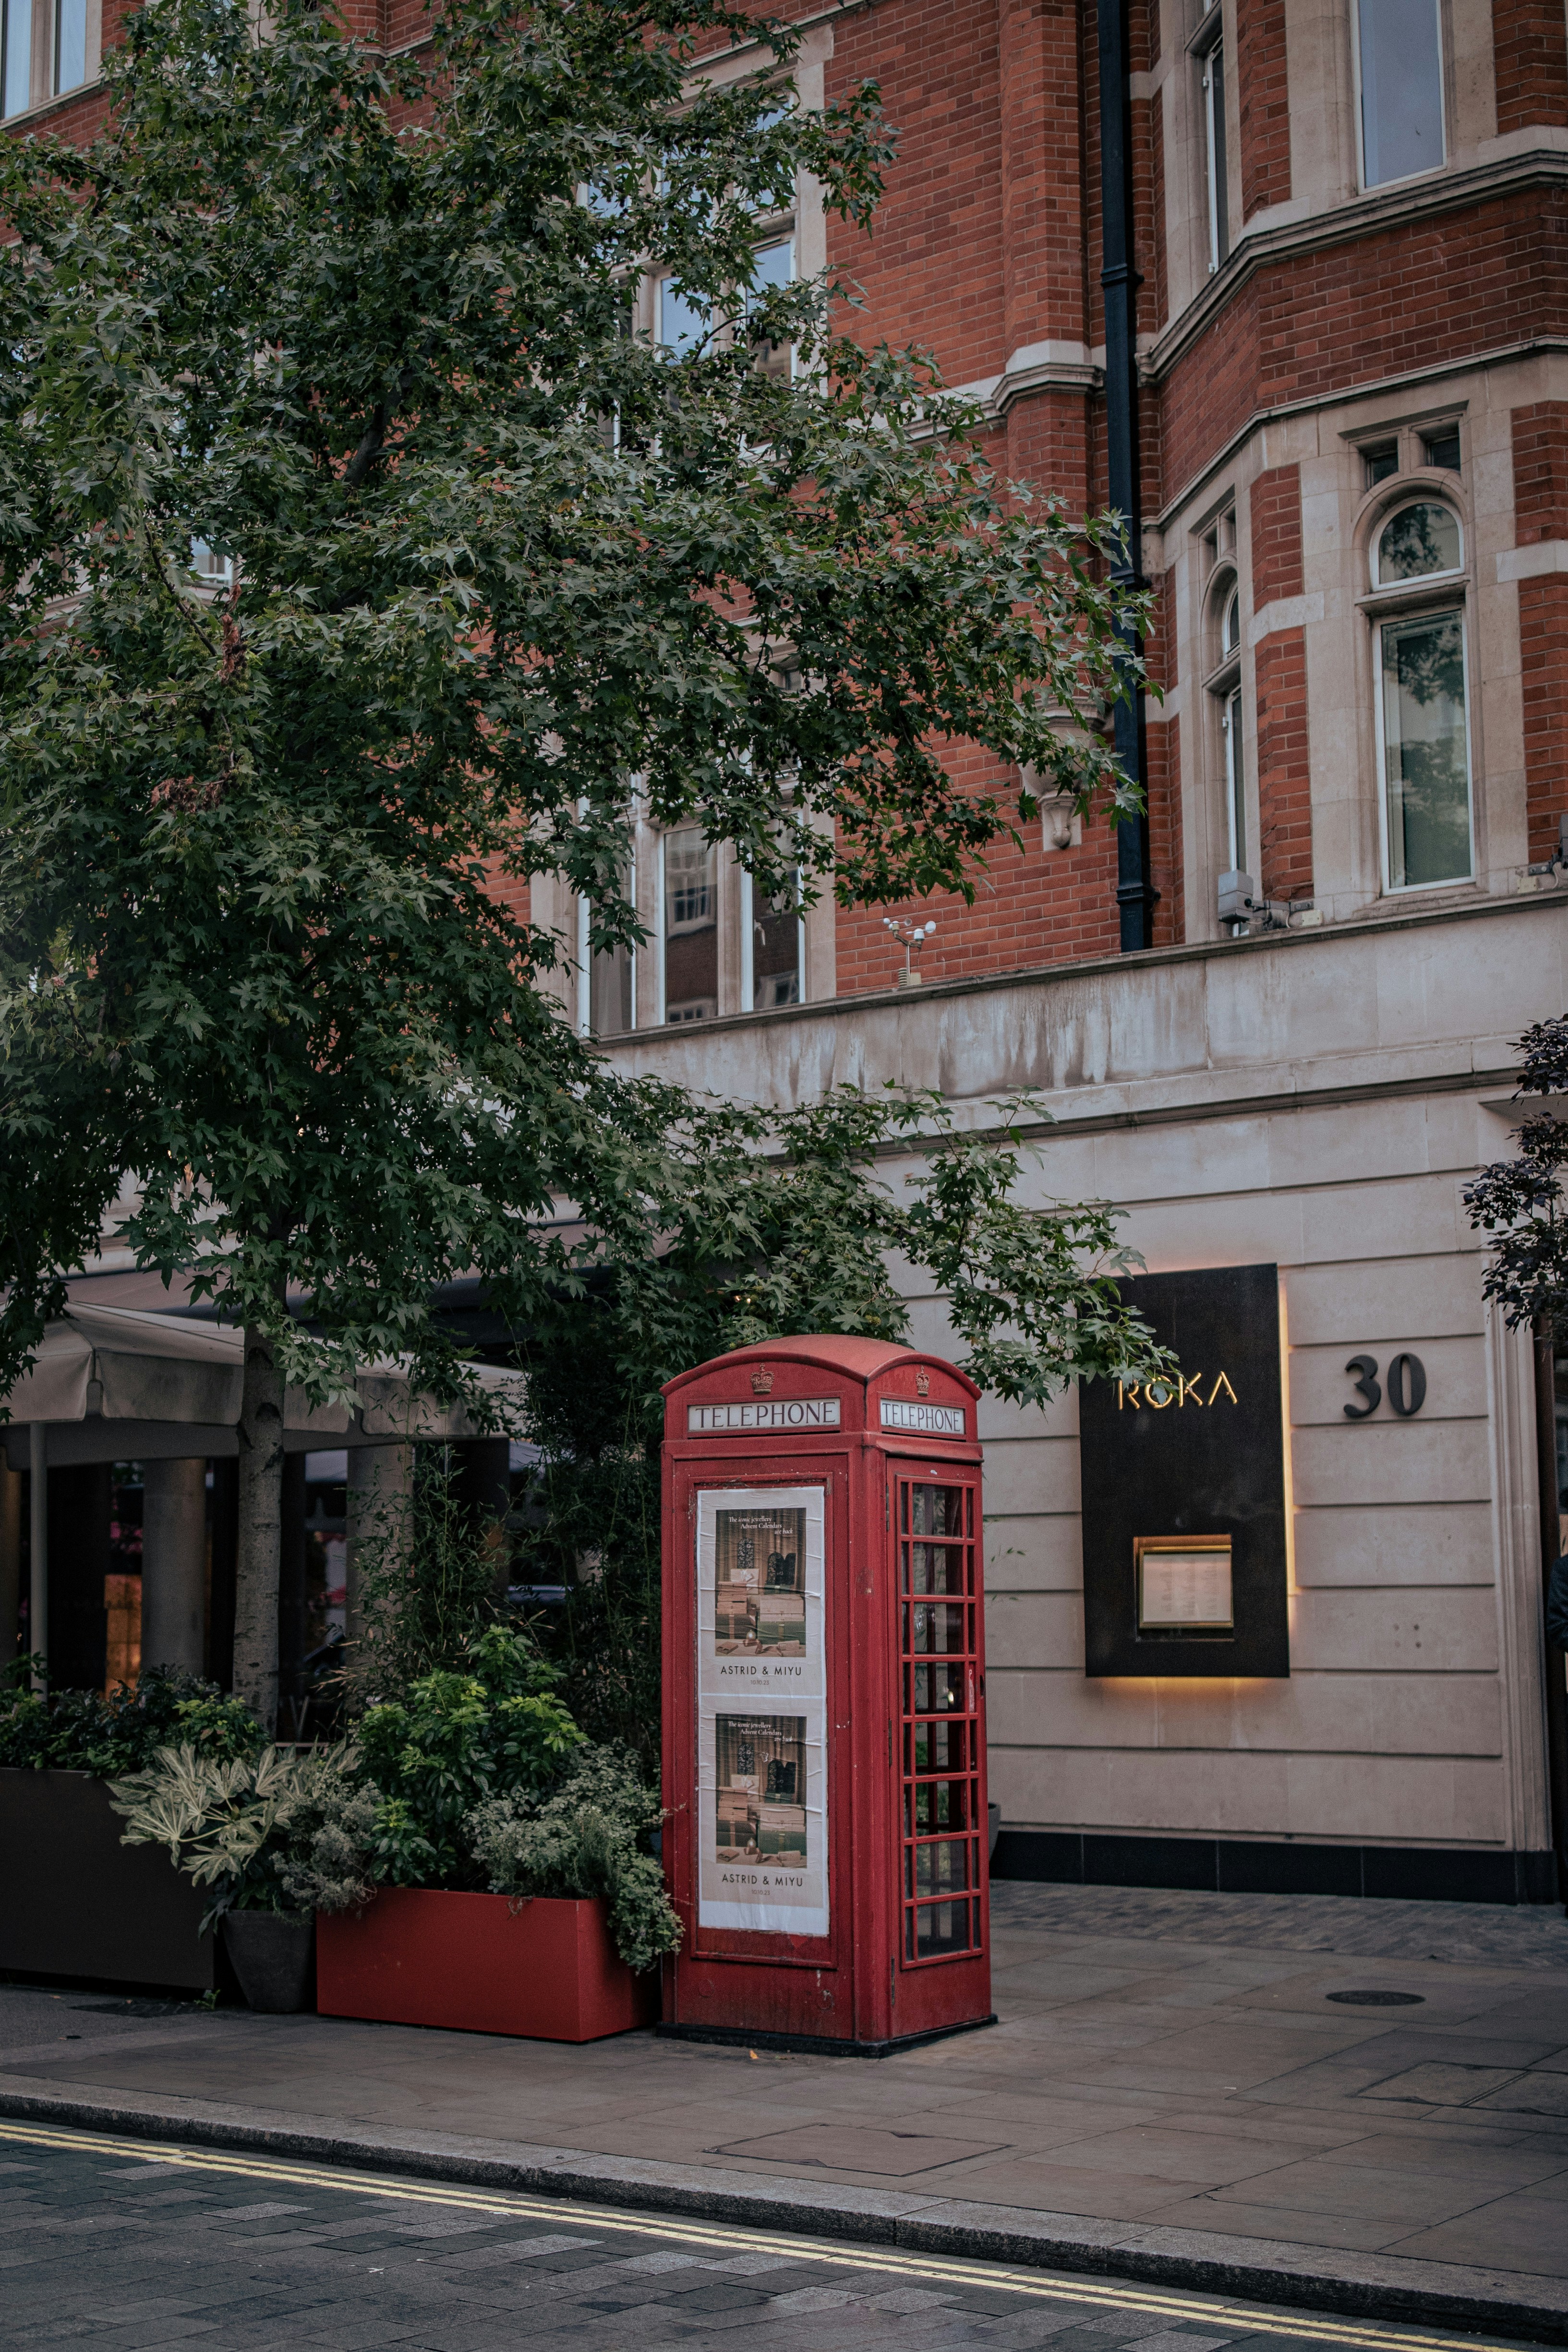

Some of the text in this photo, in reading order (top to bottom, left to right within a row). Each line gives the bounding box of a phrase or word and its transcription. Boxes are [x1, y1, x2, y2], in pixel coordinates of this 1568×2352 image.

[1118, 1371, 1238, 1410] ROKA
[1344, 1352, 1427, 1419] 30
[695, 1401, 836, 1428] TELEPHONE
[881, 1402, 961, 1432] TELEPHONE
[721, 1666, 802, 1676] ASTRID & MIYU
[751, 1722, 772, 1730] jewellery
[722, 1873, 803, 1887] ASTRID & MIYU
